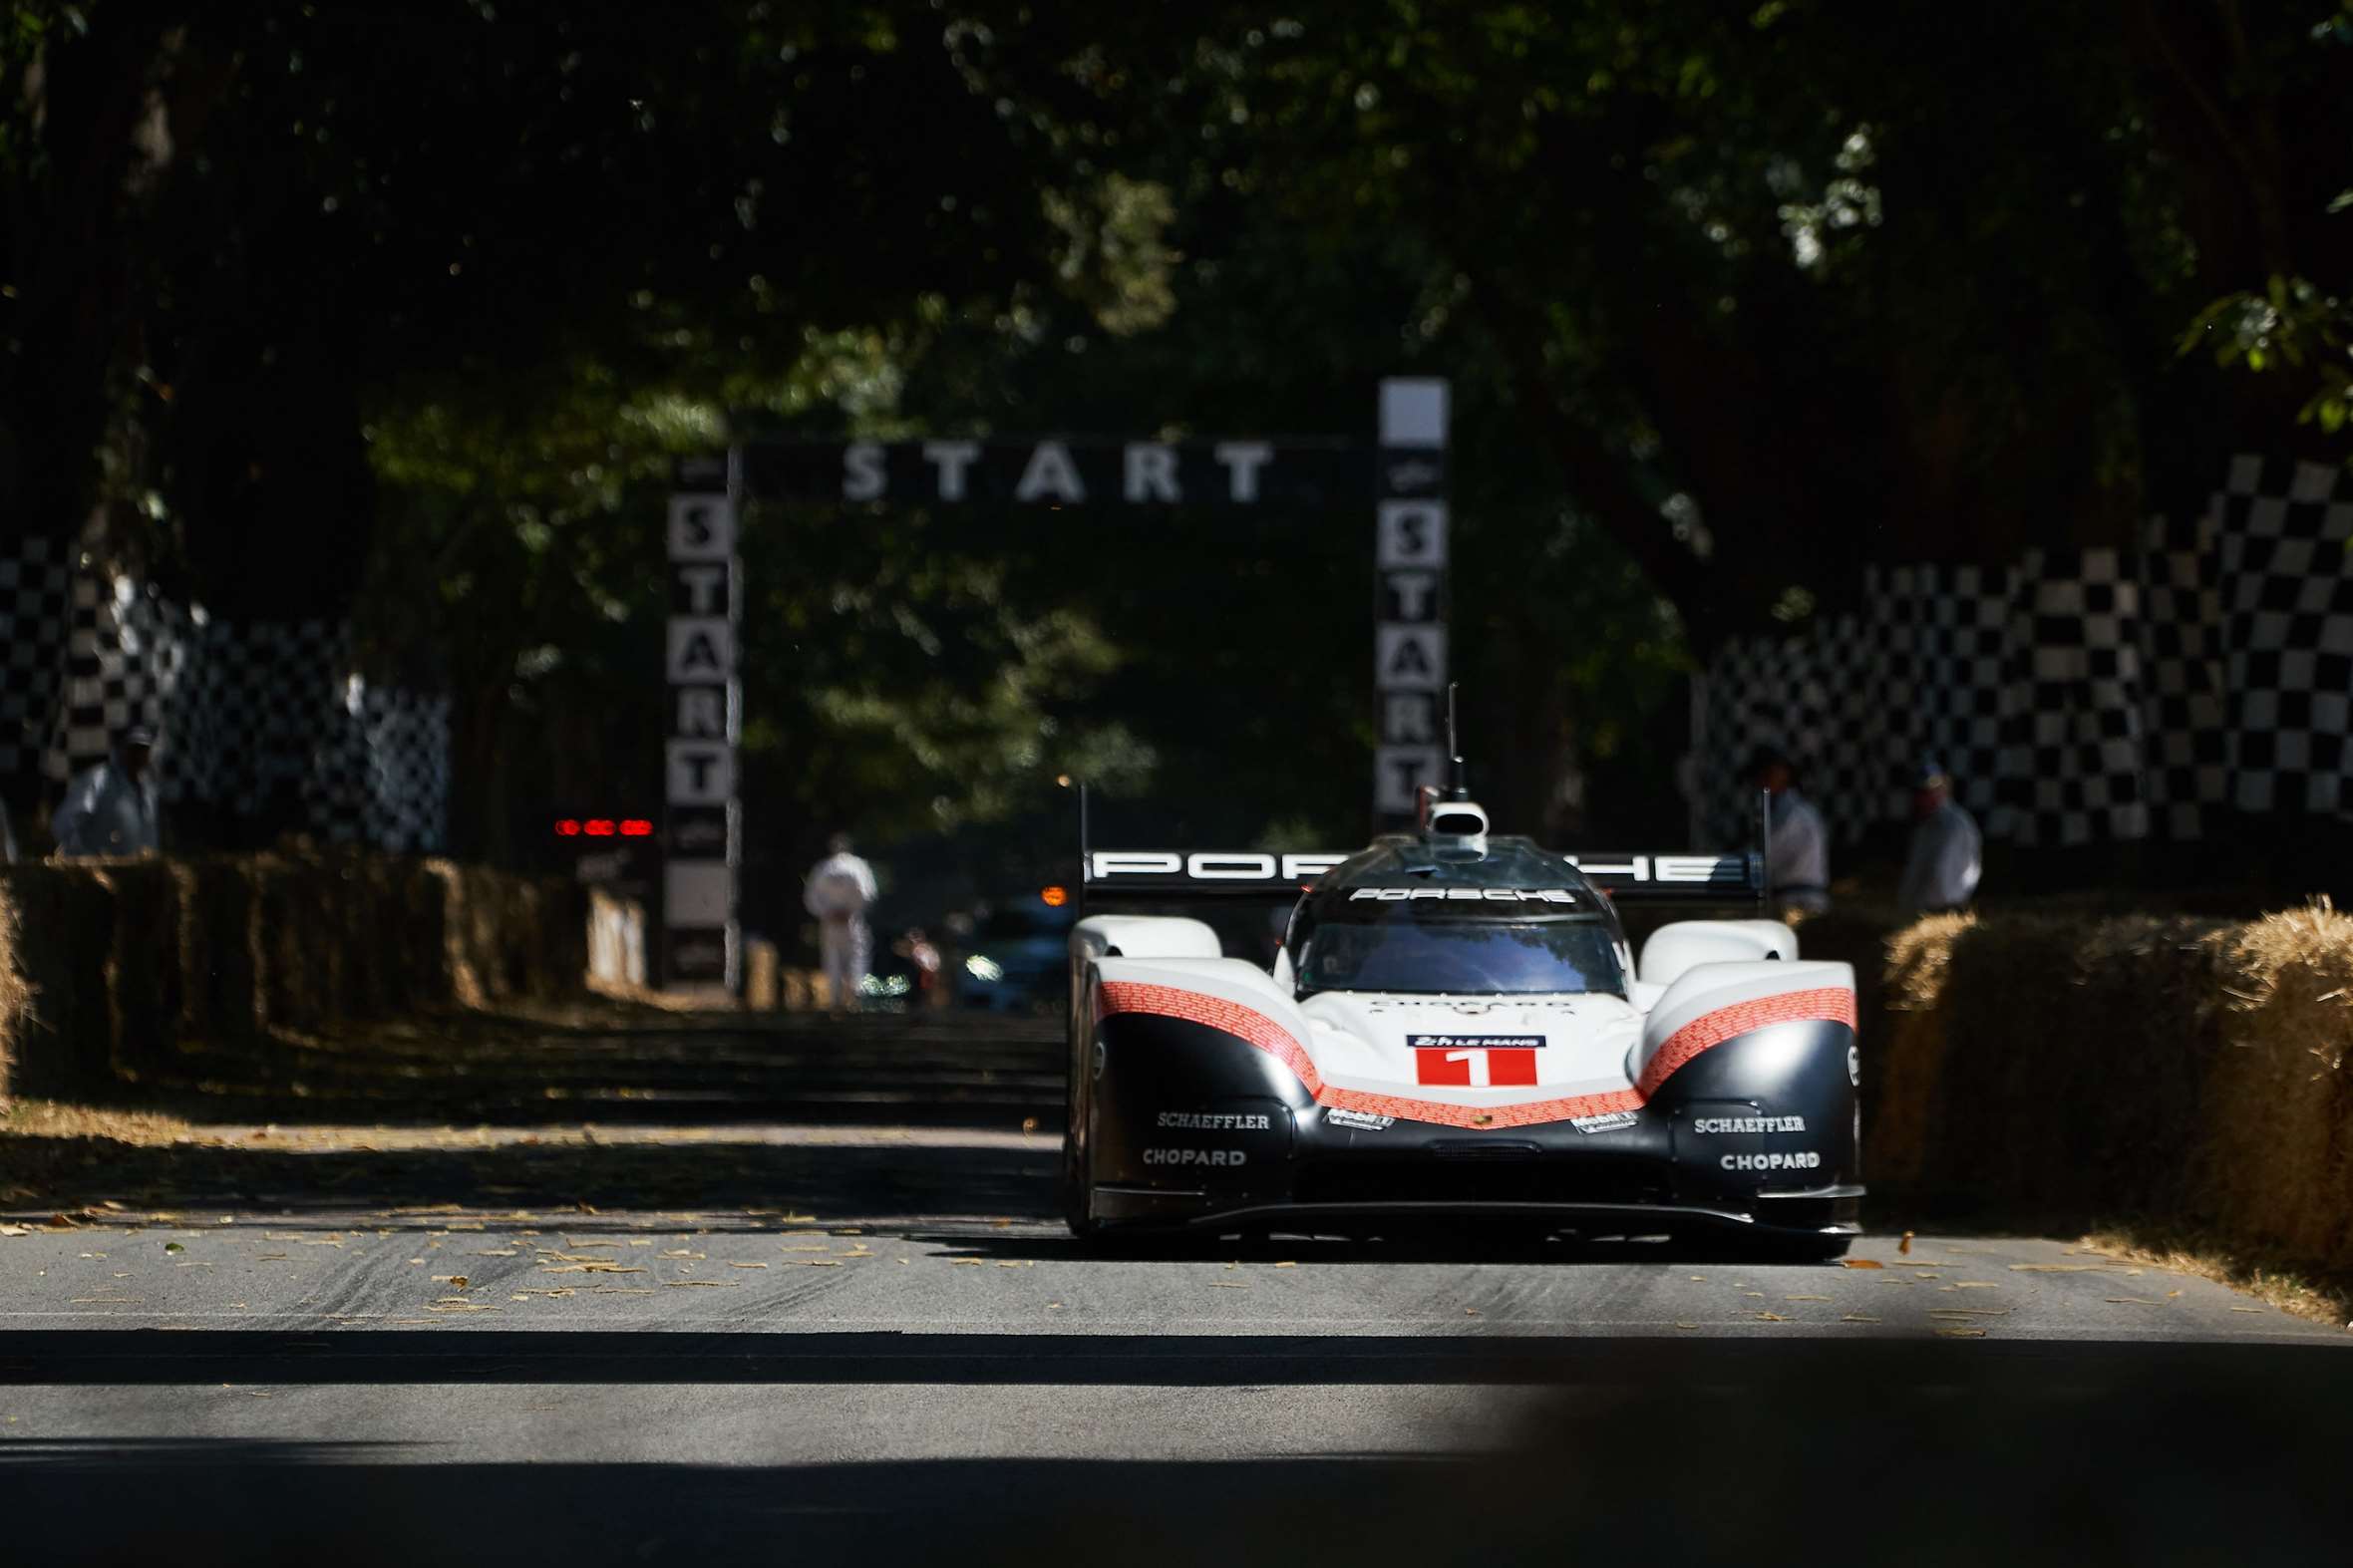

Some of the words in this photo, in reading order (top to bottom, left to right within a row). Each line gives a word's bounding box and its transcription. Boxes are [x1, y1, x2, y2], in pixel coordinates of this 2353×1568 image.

[841, 441, 1274, 501] START
[678, 504, 724, 791] START
[1386, 511, 1435, 795] START
[1093, 851, 1743, 882] PORHE
[1349, 887, 1576, 902] PORSCHE
[1482, 1038, 1539, 1048] MANS
[1446, 1049, 1491, 1087] 1
[1157, 1111, 1270, 1129] SCHAEFFLER
[1695, 1115, 1806, 1133] SCHAEFFLER
[1143, 1148, 1246, 1165] CHOPARD
[1720, 1151, 1821, 1170] CHOPARD
